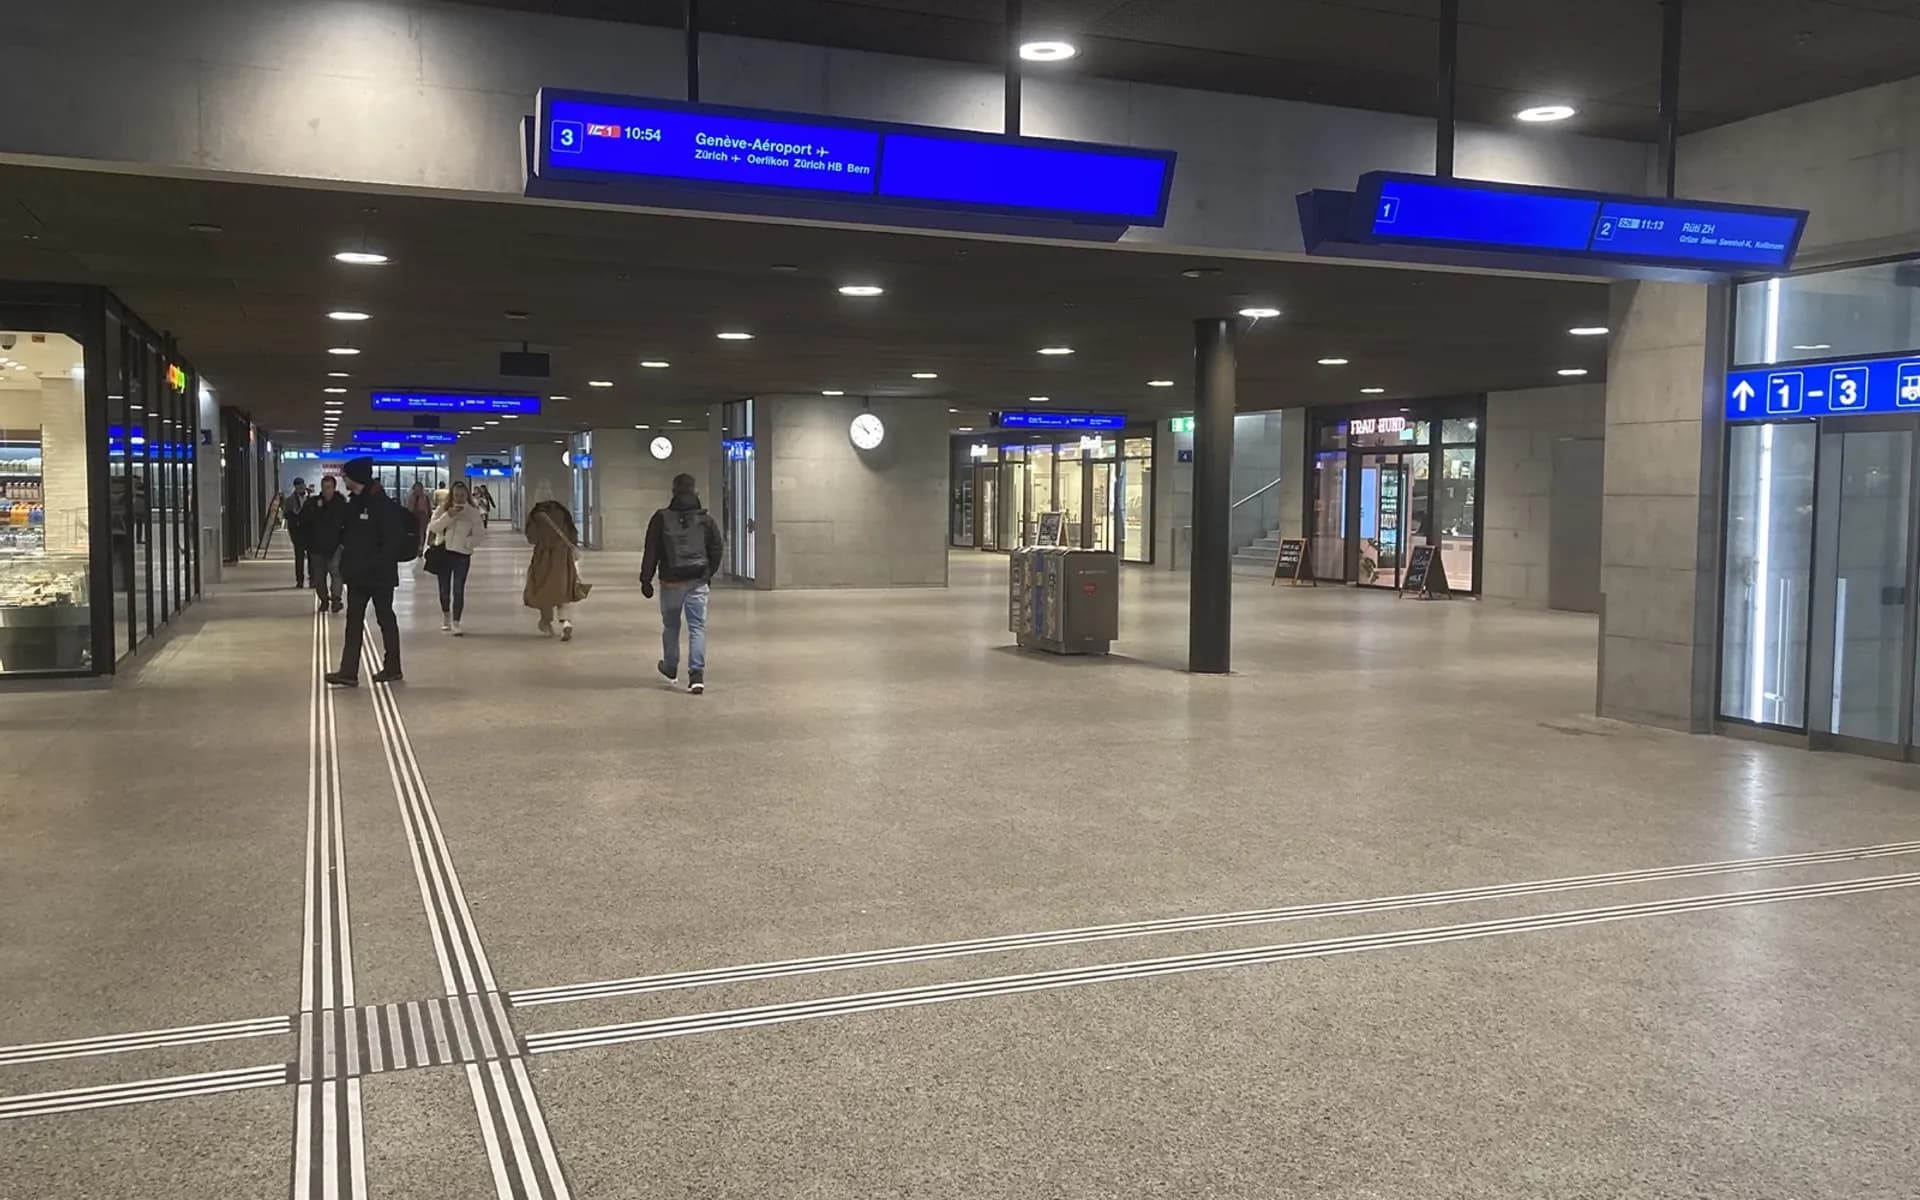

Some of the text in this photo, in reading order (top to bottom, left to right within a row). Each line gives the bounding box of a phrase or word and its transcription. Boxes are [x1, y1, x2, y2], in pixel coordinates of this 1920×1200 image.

[561, 129, 573, 146] 3
[625, 126, 661, 142] 10:54
[695, 132, 812, 156] Genève-Aéroport
[695, 149, 870, 175] Zürich Oerlikon Zürich HB Bern
[1384, 203, 1391, 217] 1
[1600, 222, 1611, 236] 2
[1641, 219, 1665, 230] 11:13
[1682, 222, 1715, 234] Rüti ZH
[1777, 385, 1789, 408] 1
[1839, 379, 1857, 405] 3
[1350, 417, 1405, 435] FRAU HUND
